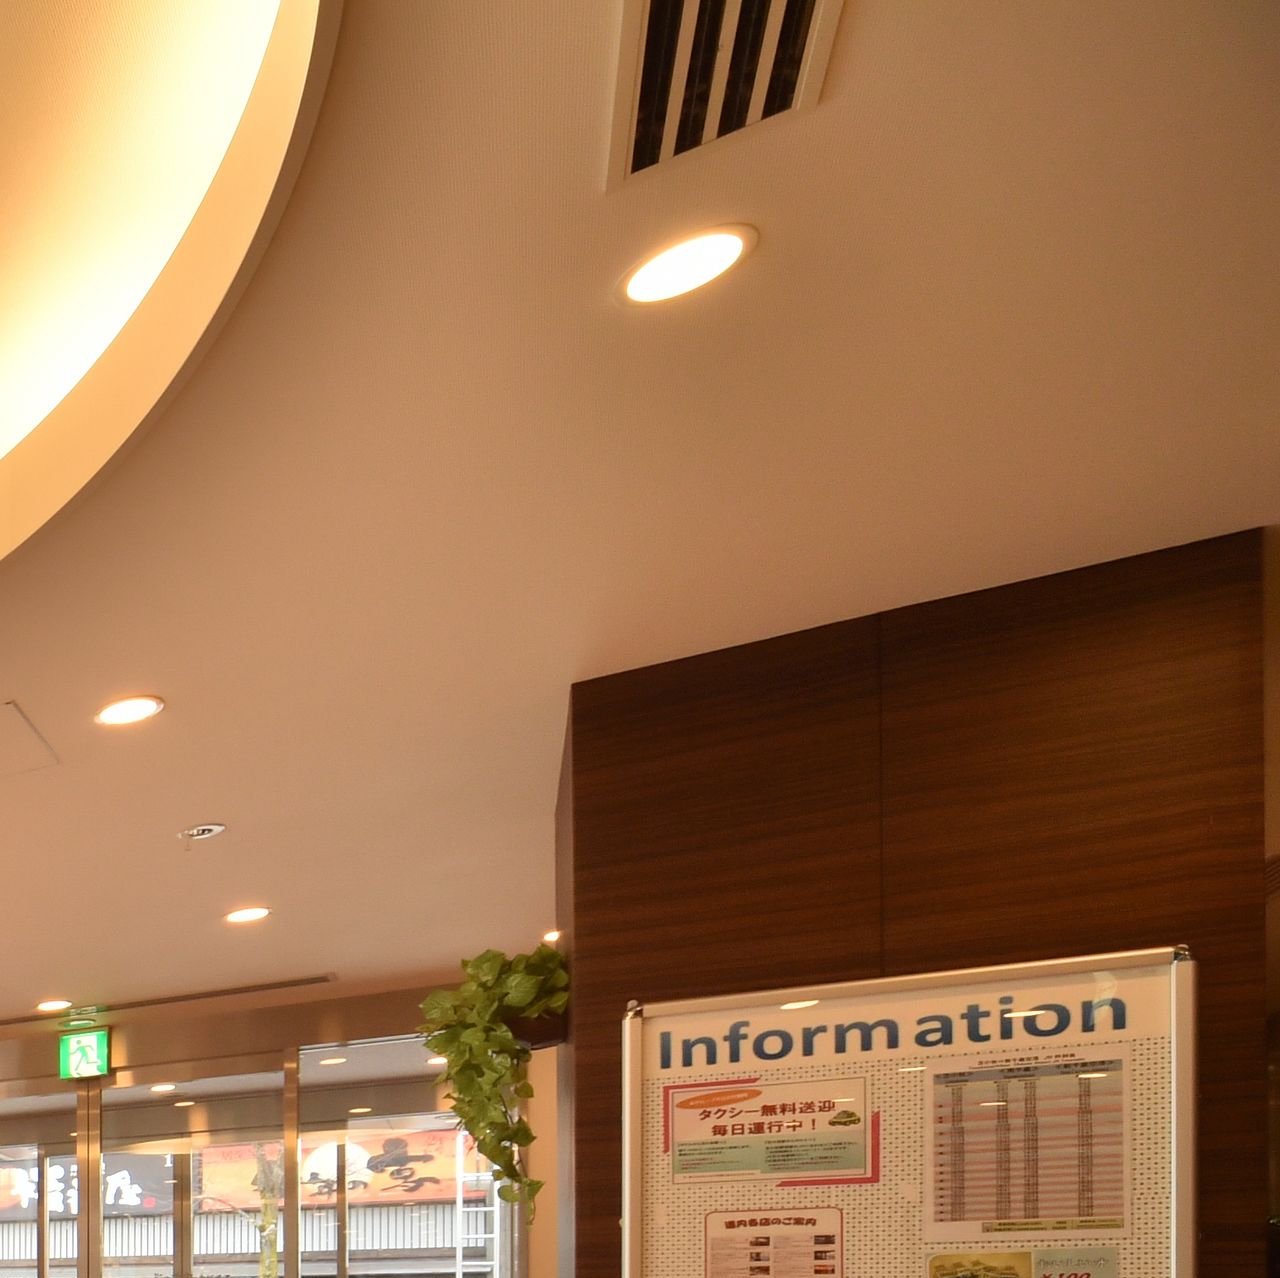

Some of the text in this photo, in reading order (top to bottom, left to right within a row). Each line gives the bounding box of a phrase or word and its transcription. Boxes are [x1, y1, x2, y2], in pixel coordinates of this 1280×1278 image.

[659, 995, 1127, 1070] Information
[698, 1099, 836, 1121] タクシー無料送迎
